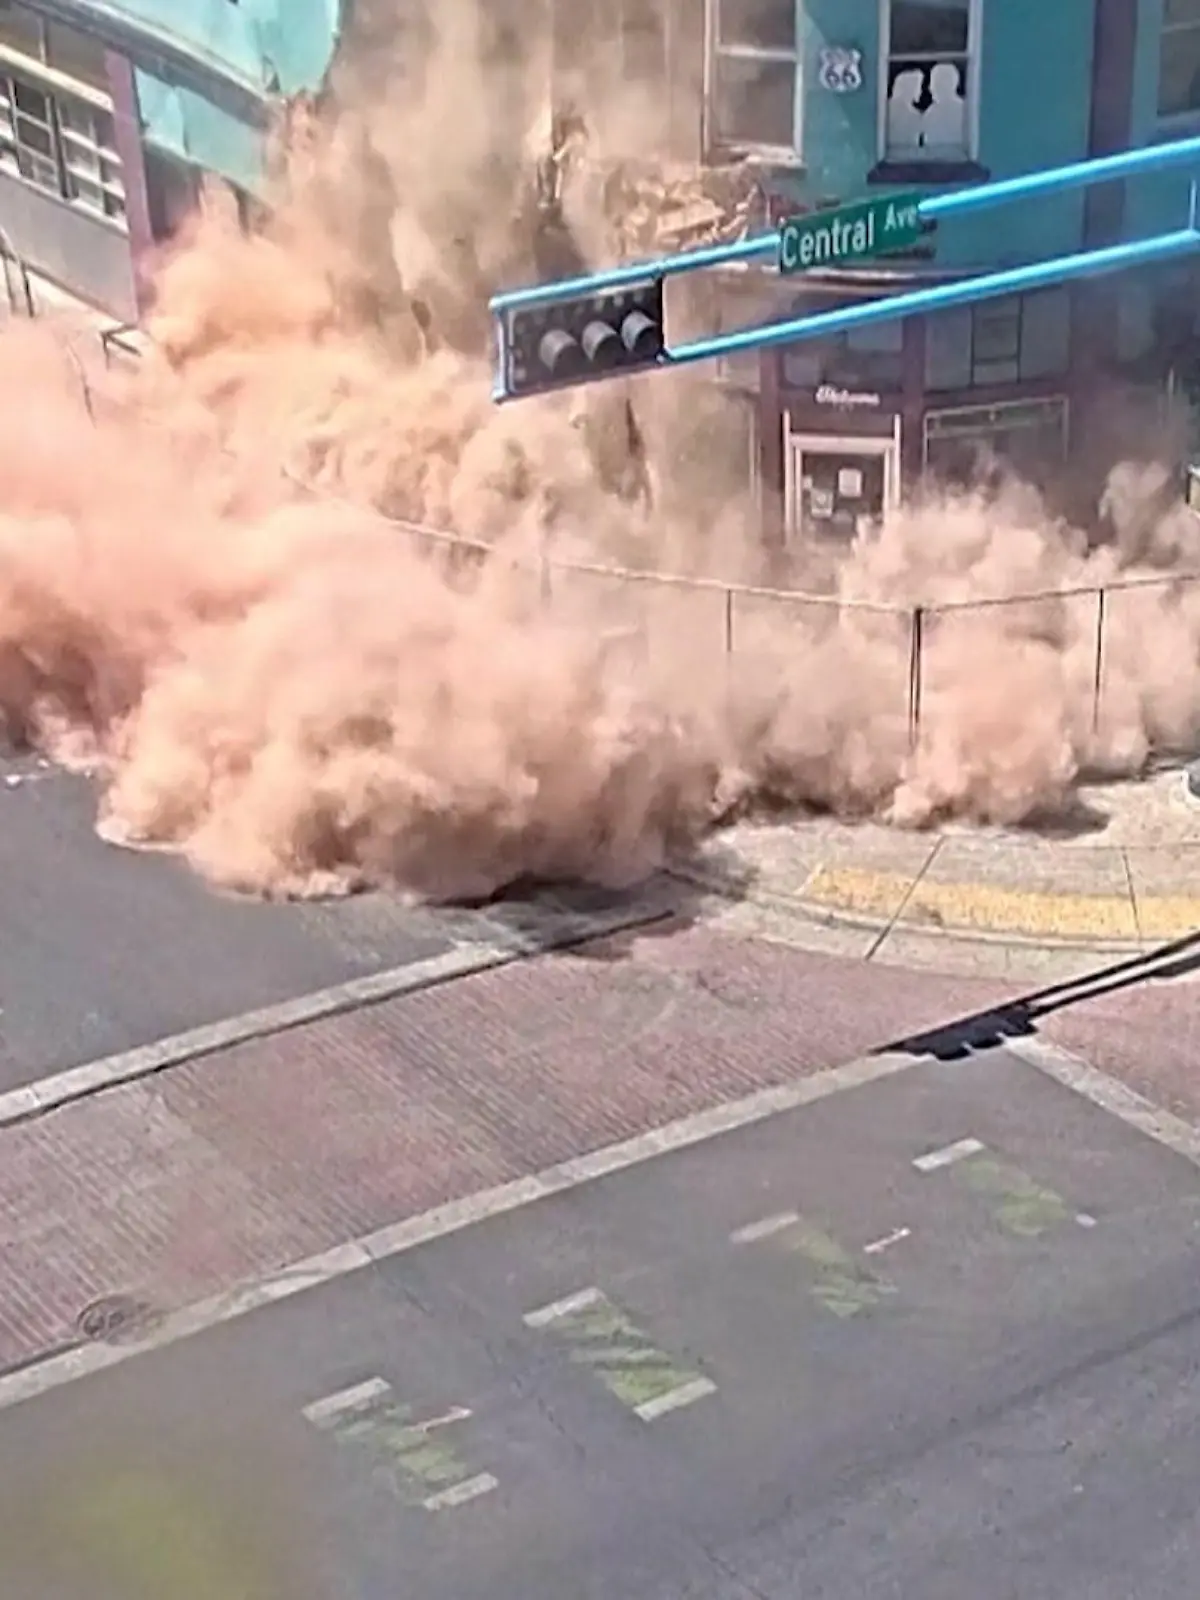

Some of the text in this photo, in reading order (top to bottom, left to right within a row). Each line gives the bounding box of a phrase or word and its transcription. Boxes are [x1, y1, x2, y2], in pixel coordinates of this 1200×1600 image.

[826, 63, 857, 88] 66
[782, 202, 918, 267] Central Ave
